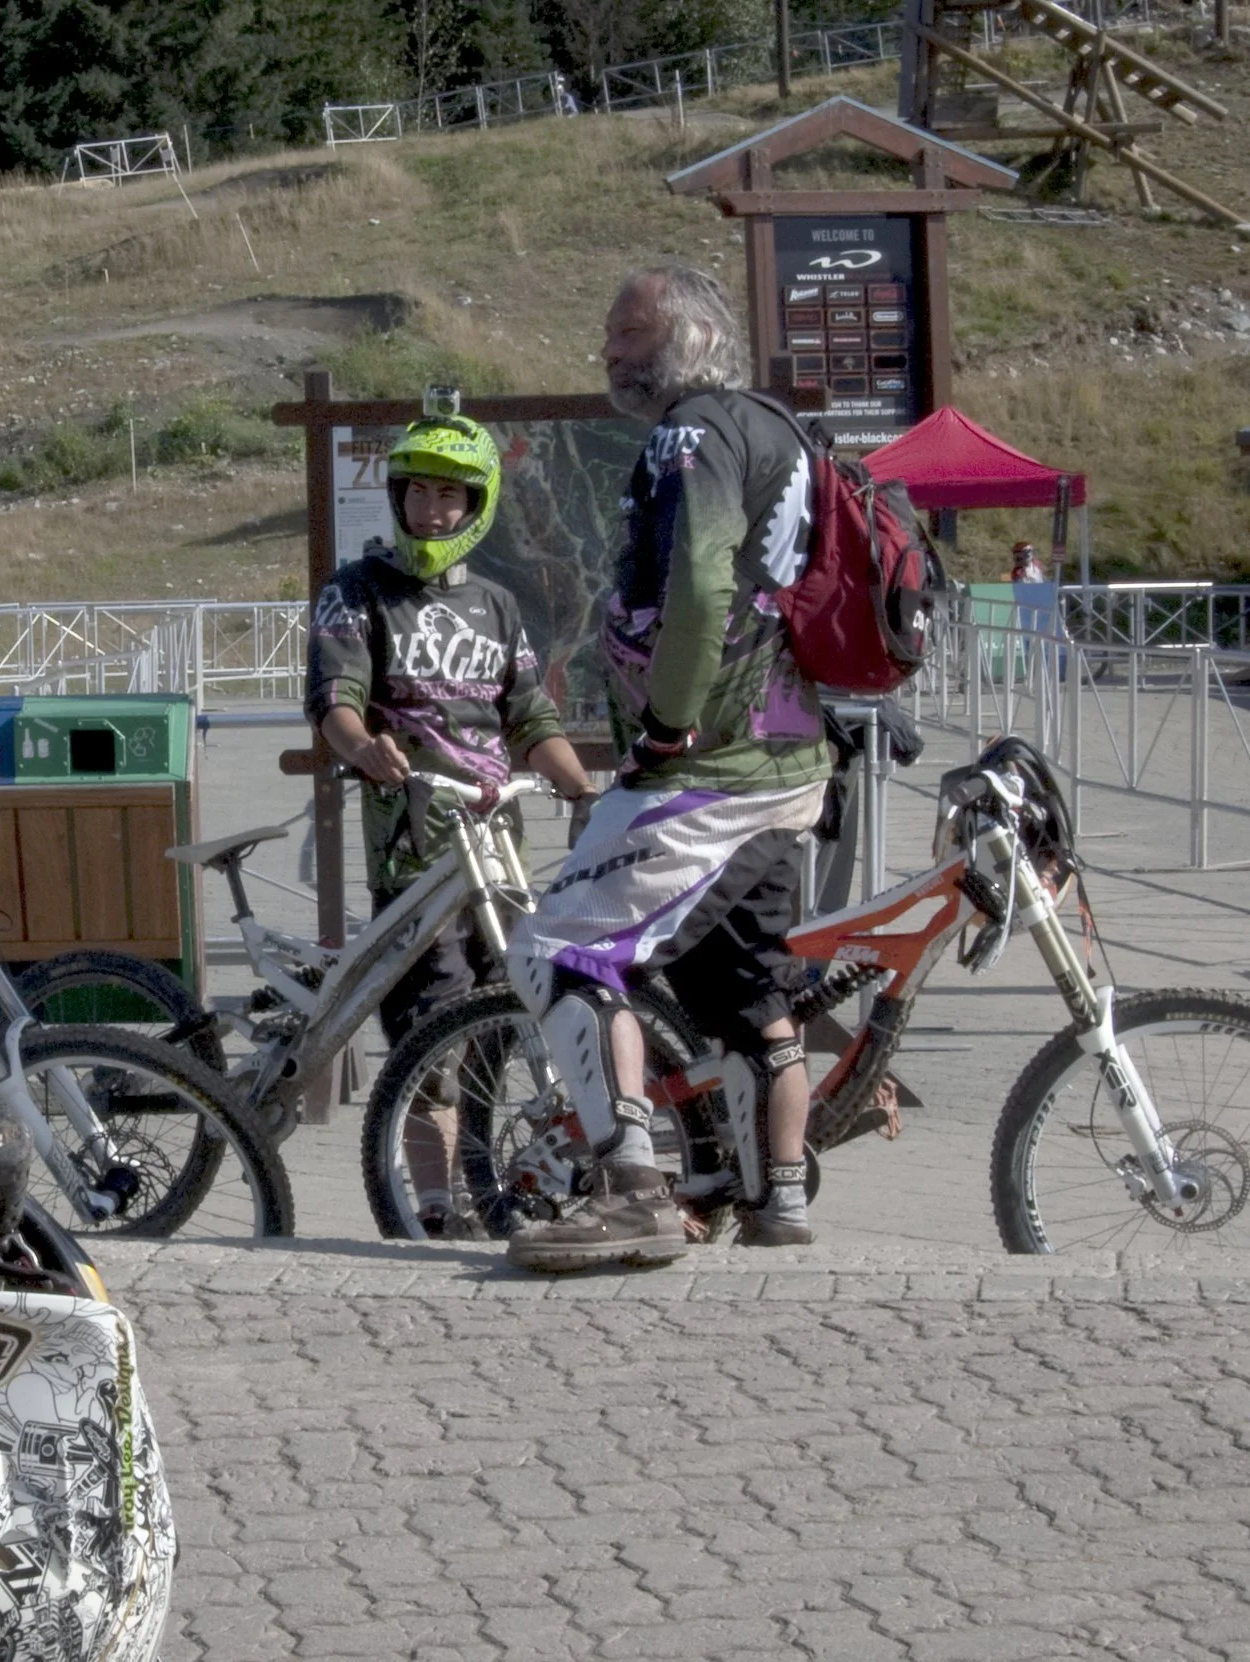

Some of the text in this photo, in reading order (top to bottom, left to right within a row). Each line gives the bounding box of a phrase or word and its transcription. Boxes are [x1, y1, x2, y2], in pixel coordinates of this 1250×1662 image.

[811, 228, 875, 242] WELCOME TO
[387, 631, 442, 678] LES
[120, 1430, 134, 1479] Lee
